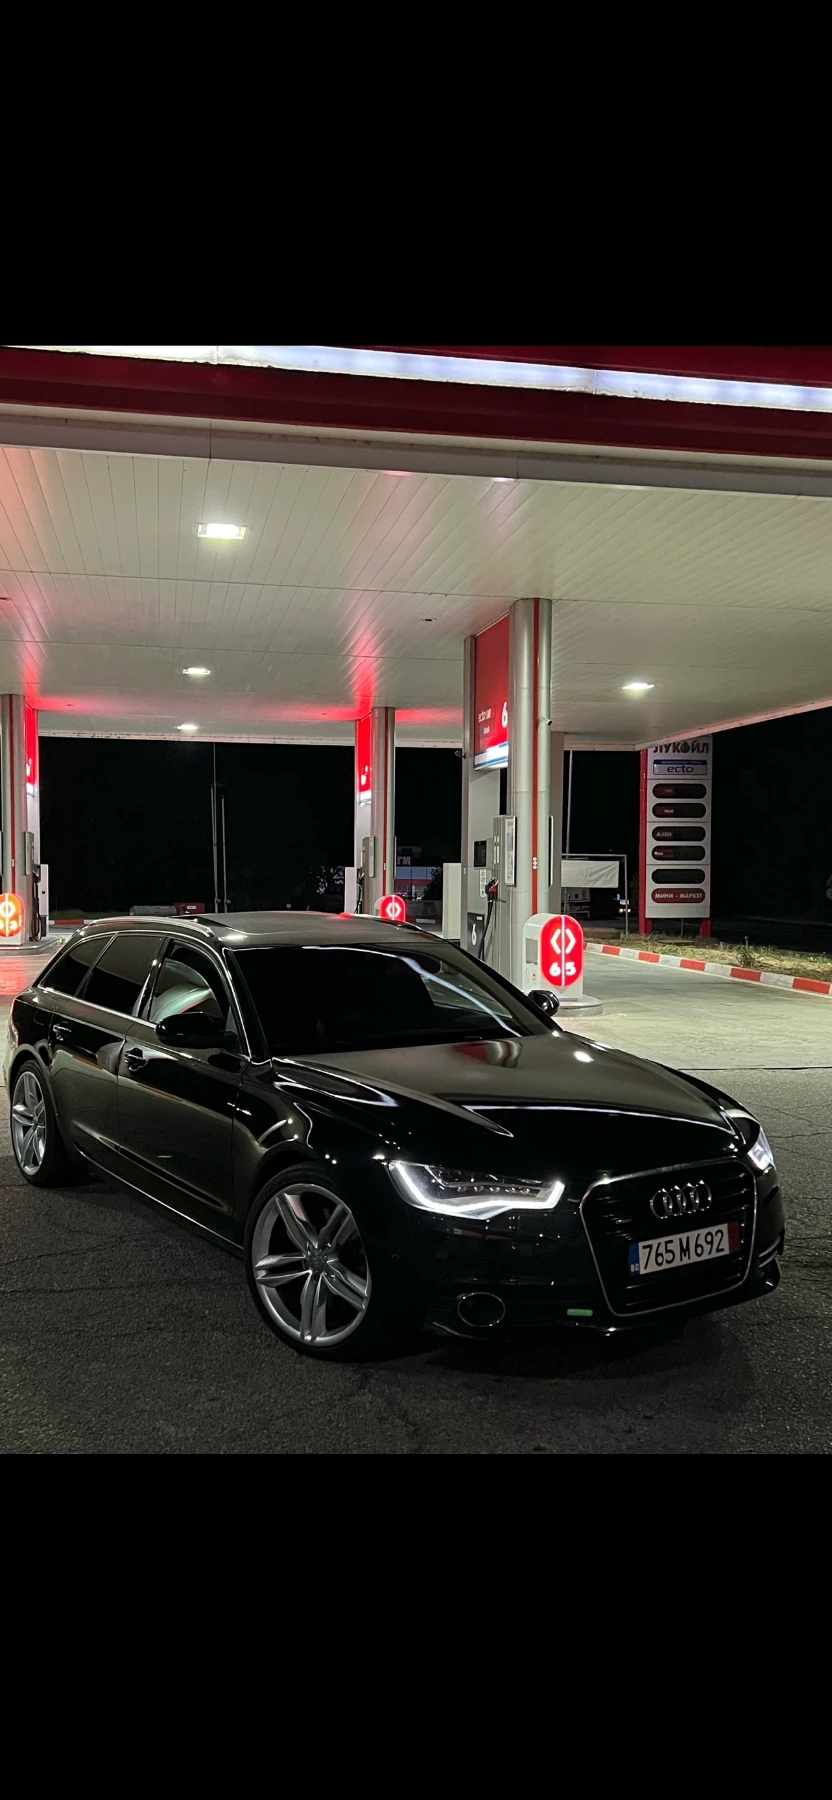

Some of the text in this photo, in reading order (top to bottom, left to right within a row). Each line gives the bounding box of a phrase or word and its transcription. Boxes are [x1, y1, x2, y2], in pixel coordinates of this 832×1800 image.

[502, 701, 508, 728] 6
[667, 765, 694, 773] ecto
[471, 923, 477, 946] 6
[549, 961, 577, 977] 6 5
[642, 1229, 725, 1270] 765 M 692
[630, 1263, 640, 1273] BG
